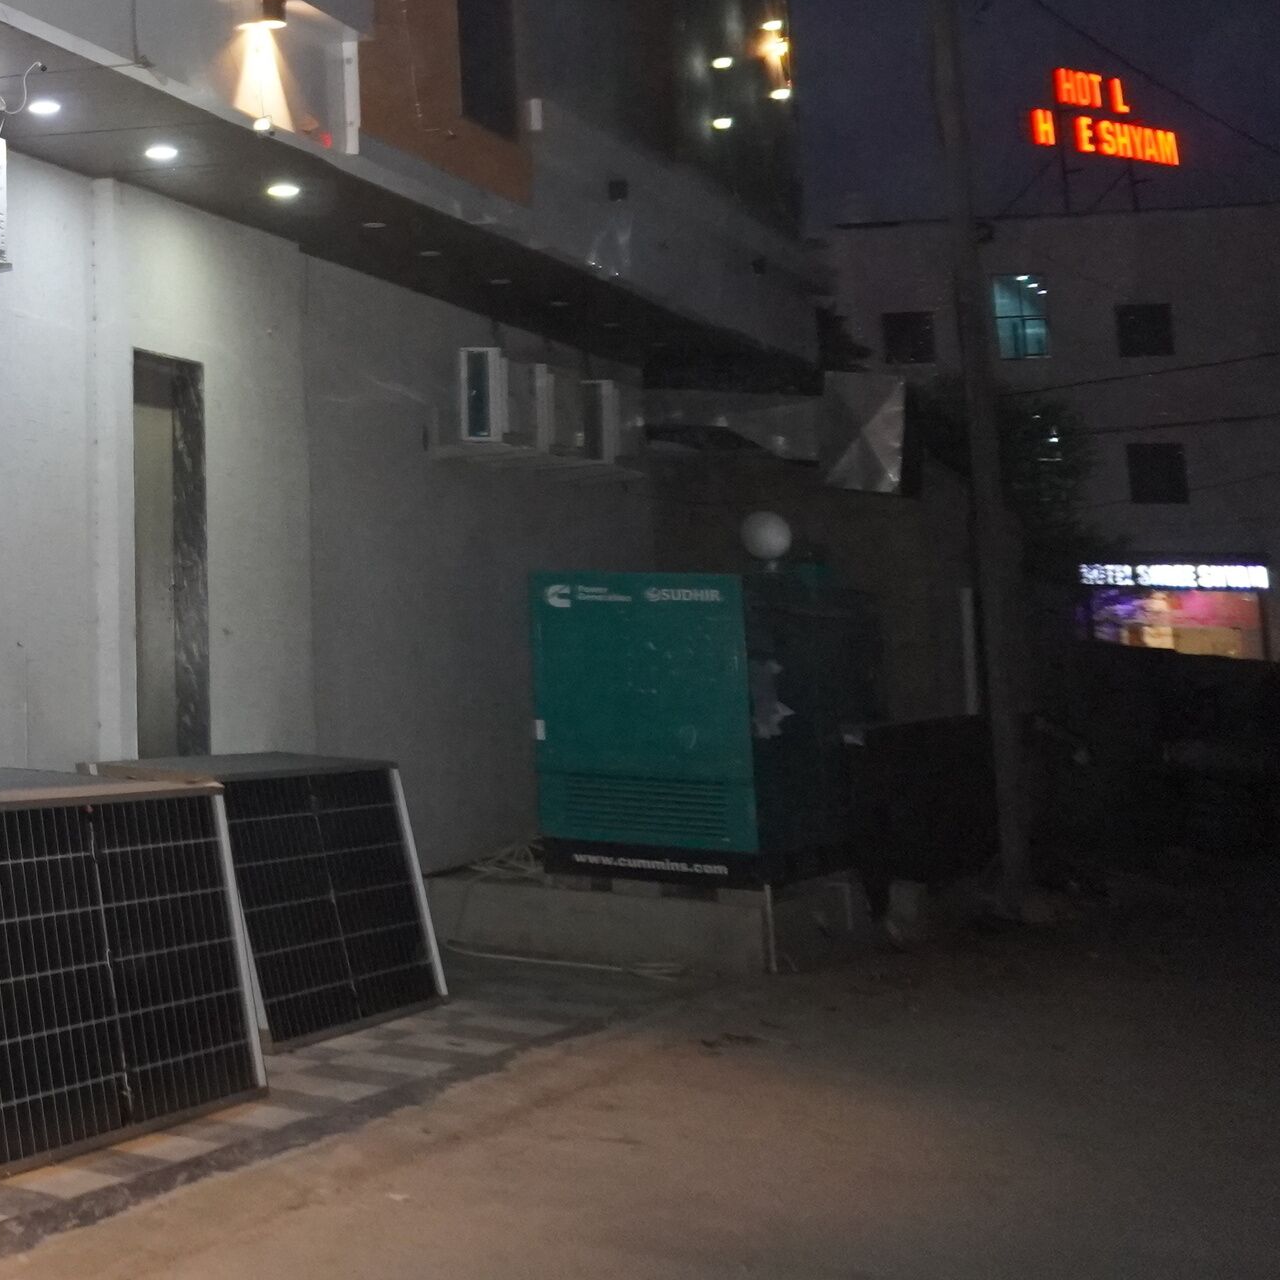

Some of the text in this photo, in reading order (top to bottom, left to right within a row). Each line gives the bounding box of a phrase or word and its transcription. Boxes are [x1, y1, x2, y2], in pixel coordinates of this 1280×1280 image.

[1095, 119, 1180, 167] SHYAM
[661, 588, 721, 602] SUDHIR
[572, 853, 729, 876] www.cummins.com
